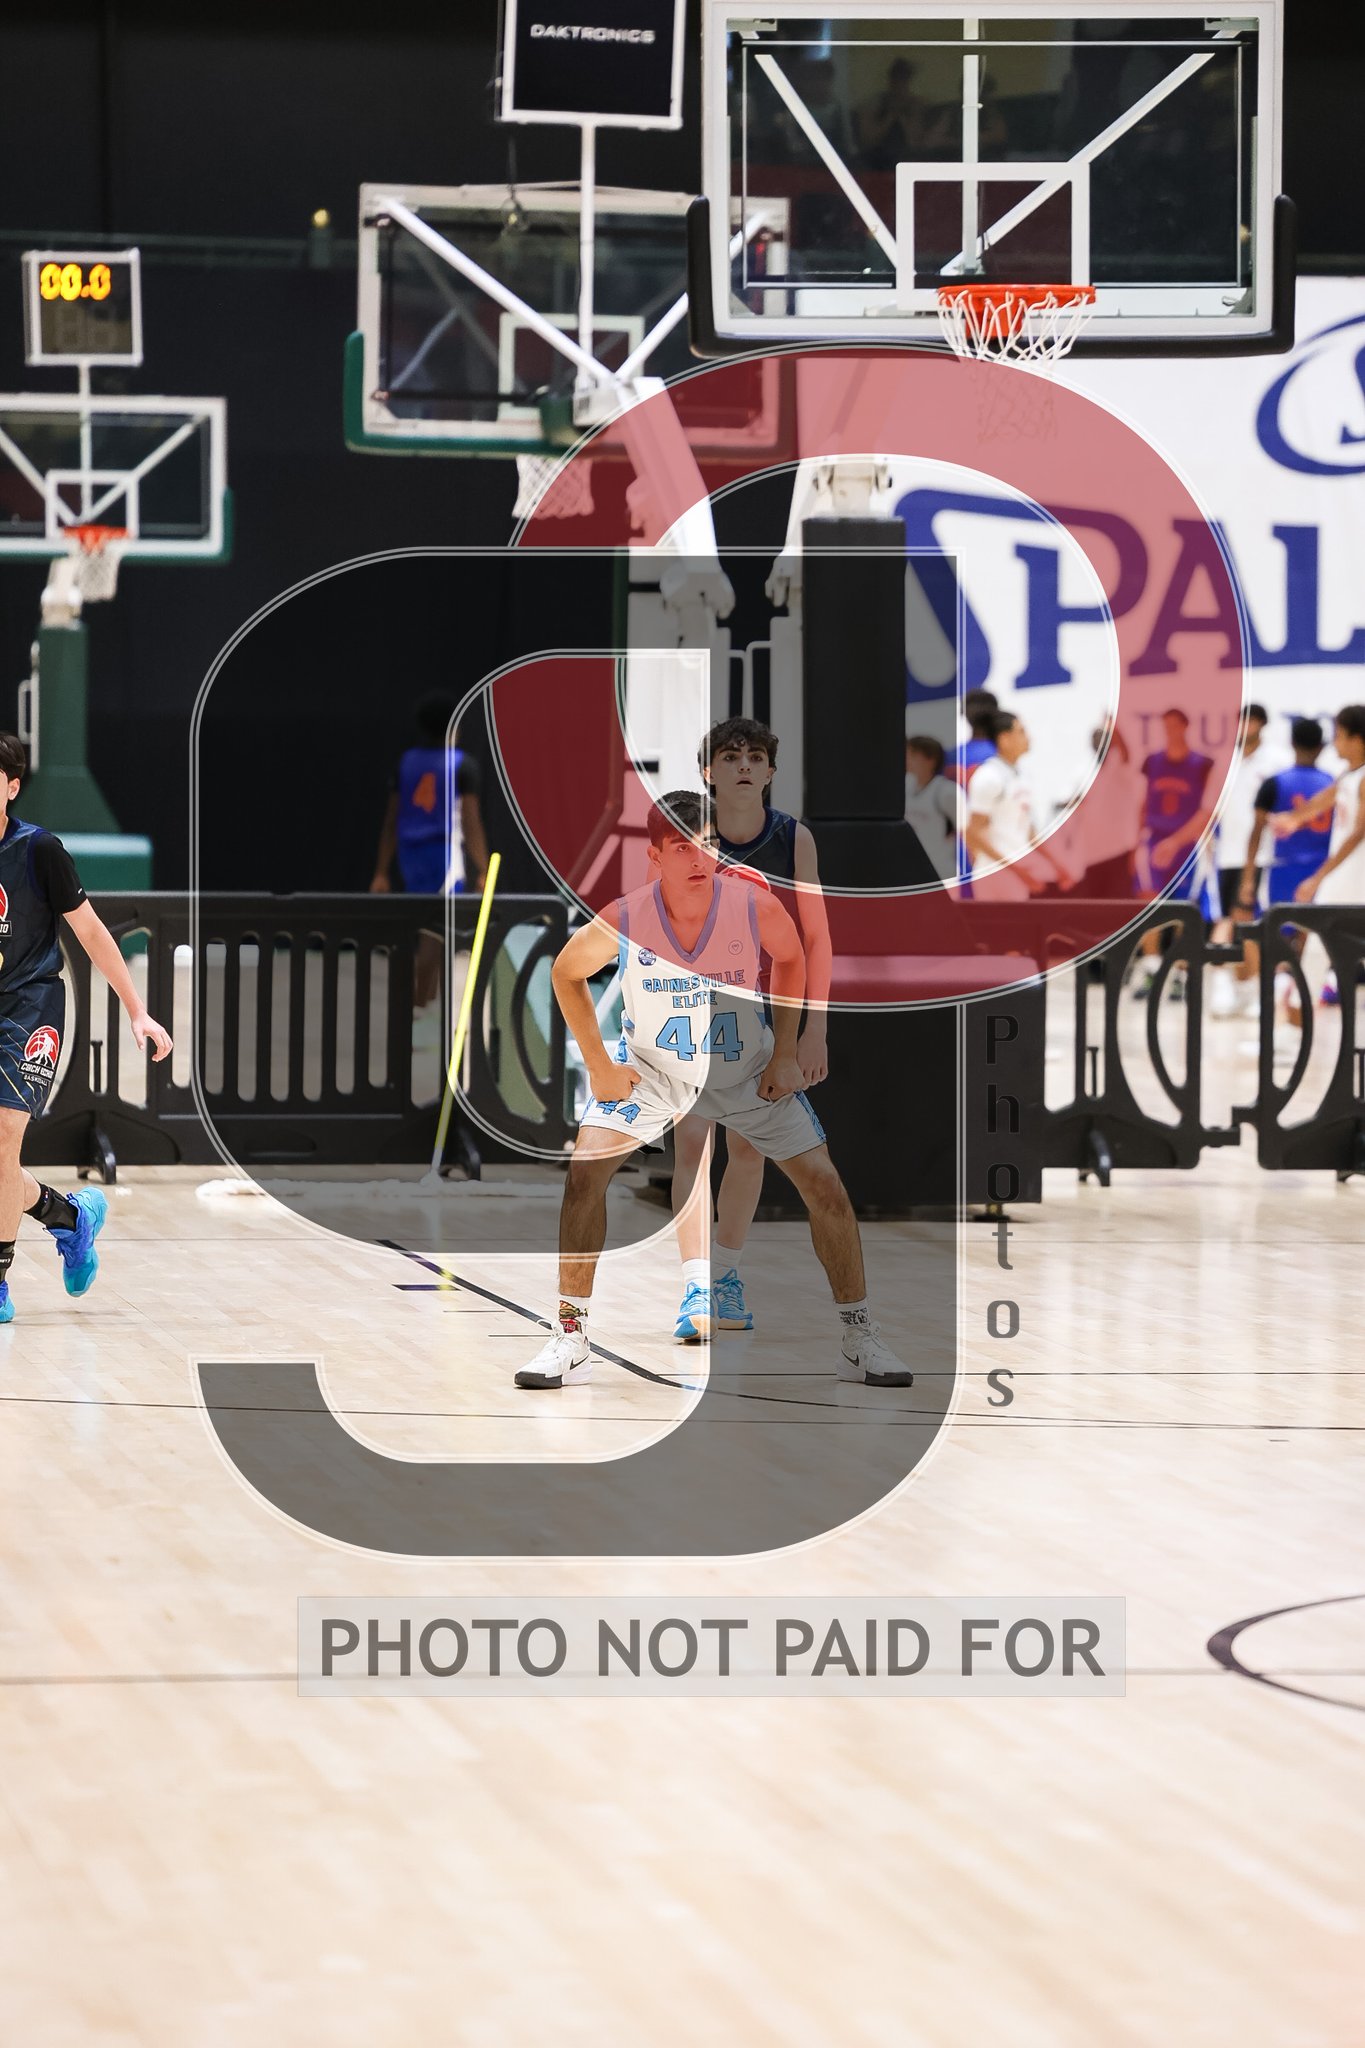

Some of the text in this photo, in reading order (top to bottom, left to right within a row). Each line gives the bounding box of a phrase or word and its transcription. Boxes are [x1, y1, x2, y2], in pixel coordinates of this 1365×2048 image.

[530, 24, 656, 44] DAKTRONICS
[40, 262, 111, 301] 00.0
[642, 968, 746, 993] GAINESVILLE
[672, 989, 718, 1009] ELITE
[655, 1011, 744, 1062] 44
